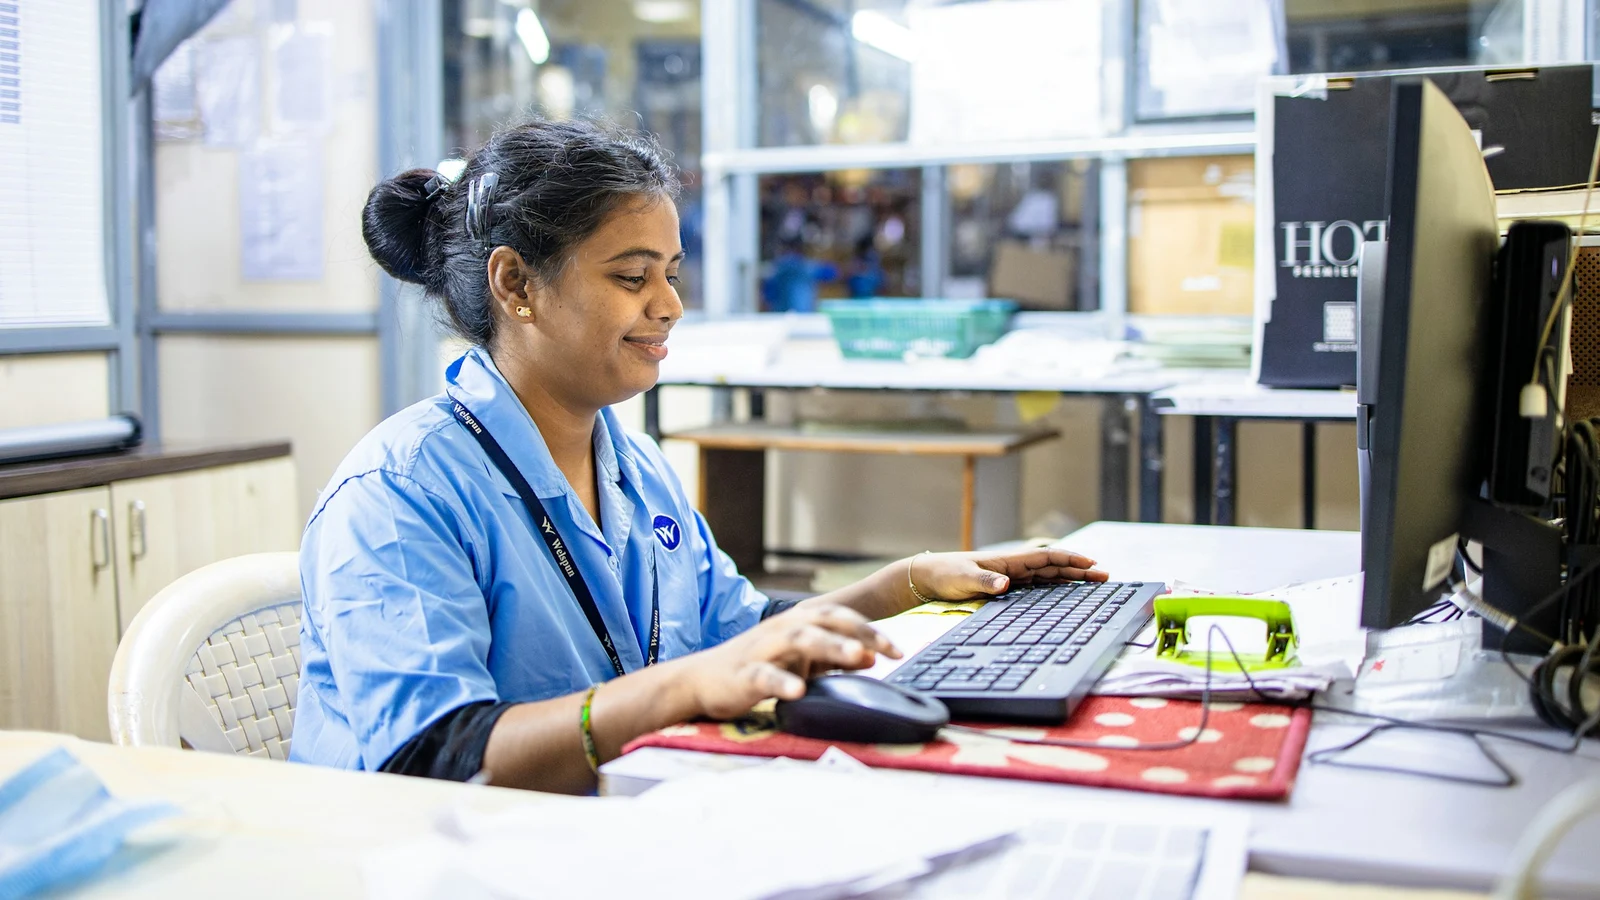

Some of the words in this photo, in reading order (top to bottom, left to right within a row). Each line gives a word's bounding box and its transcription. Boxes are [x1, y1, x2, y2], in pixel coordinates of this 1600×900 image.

[453, 403, 482, 434] Welspun
[552, 537, 575, 577] Welspun
[650, 609, 659, 647] Welspun
